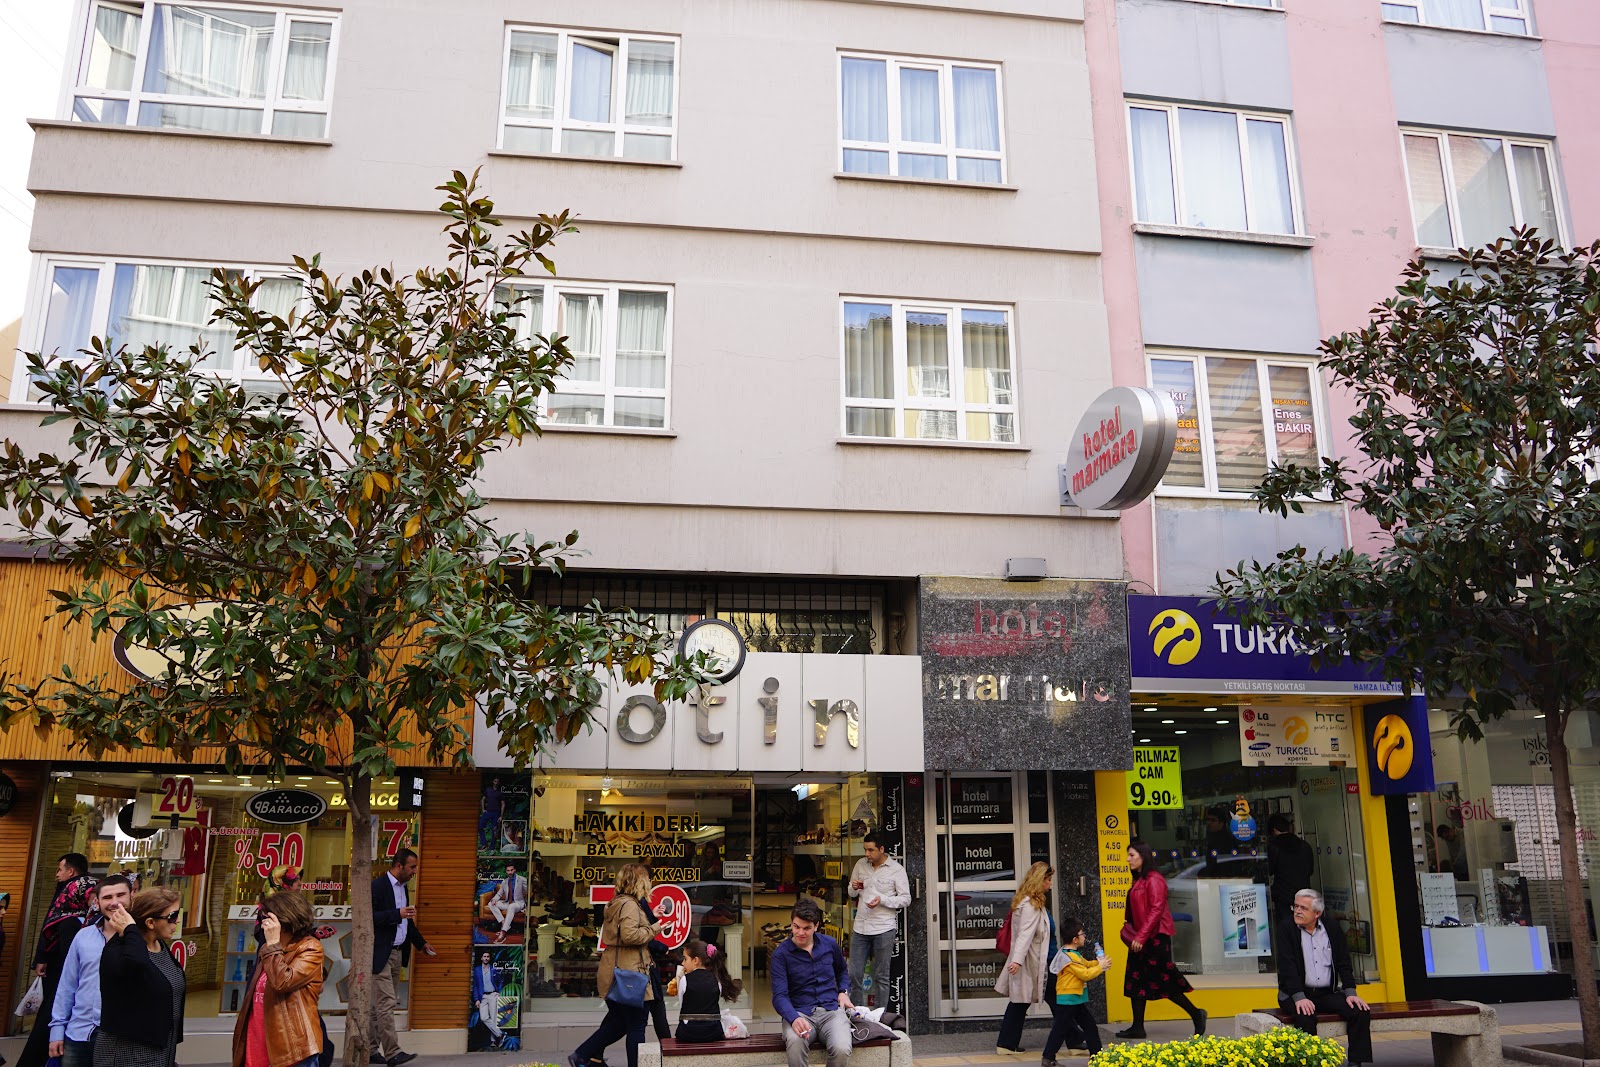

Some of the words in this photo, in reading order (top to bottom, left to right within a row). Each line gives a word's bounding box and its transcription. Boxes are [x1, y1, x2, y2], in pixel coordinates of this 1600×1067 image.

[1274, 408, 1301, 419] Enes
[1083, 405, 1121, 460] hotel
[1276, 423, 1312, 433] BAKIR
[1072, 429, 1136, 495] marmara
[973, 600, 1078, 637] hotel
[938, 675, 1115, 701] marmara
[1252, 683, 1272, 692] SATIŞ
[1274, 683, 1305, 691] NOKTASI
[1353, 683, 1378, 691] HAMZA
[554, 676, 860, 749] otin
[1276, 746, 1319, 755] TURKCELL
[1135, 750, 1177, 763] RILMAZ
[1139, 766, 1164, 779] CAM
[962, 791, 989, 801] hotel
[953, 804, 1000, 814] marmara
[574, 811, 645, 832] HAKİKİ
[653, 811, 699, 832] DERİ
[587, 844, 618, 856] BAY
[632, 844, 684, 857] BAYAN
[1105, 842, 1121, 850] 4.5G
[965, 847, 993, 858] hotel
[955, 861, 1003, 871] marmara
[573, 868, 606, 880] BOT
[650, 867, 701, 882] KKABI
[300, 881, 343, 891] NDİRİM
[966, 904, 994, 916] hotel
[956, 918, 1004, 929] marmara
[968, 962, 996, 974] hotel
[958, 977, 997, 988] marma
